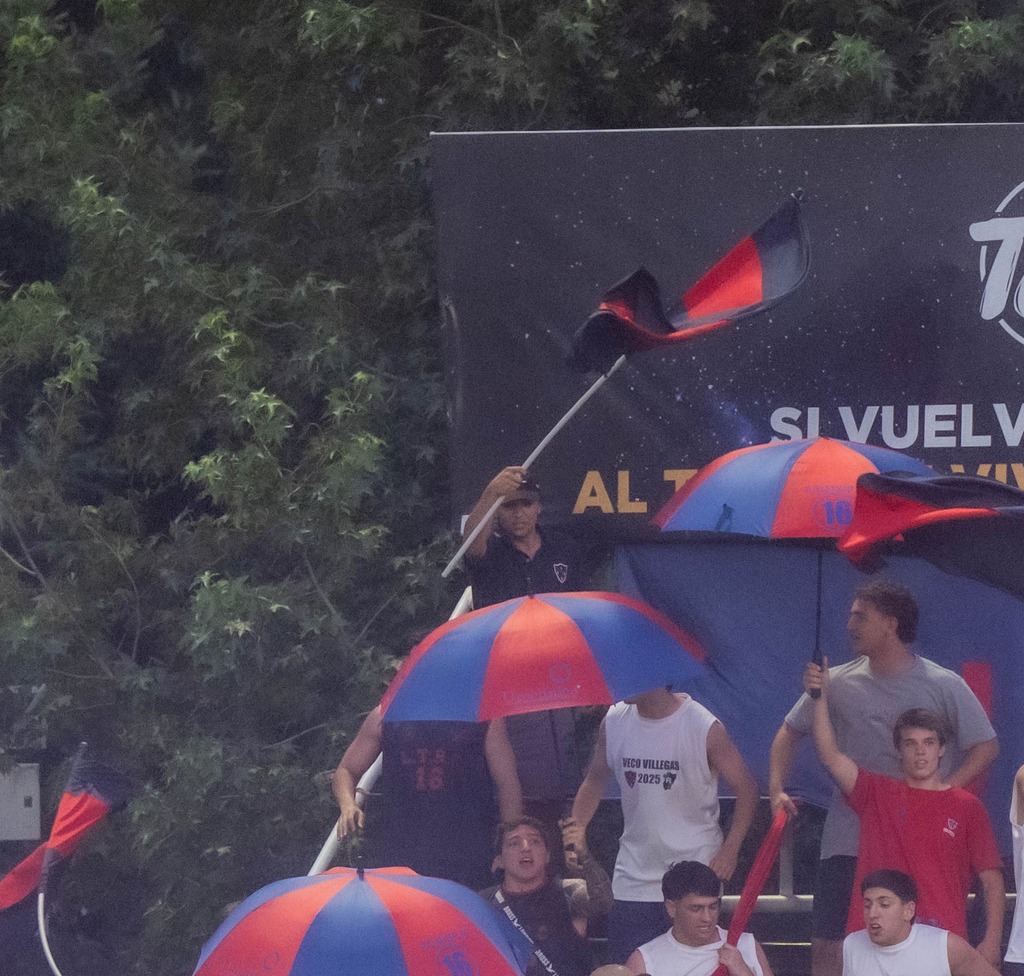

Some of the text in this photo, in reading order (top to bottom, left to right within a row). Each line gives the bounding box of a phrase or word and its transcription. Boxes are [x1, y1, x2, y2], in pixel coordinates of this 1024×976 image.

[769, 406, 820, 443] SI
[572, 470, 648, 515] AL
[622, 757, 680, 771] VECO VILLEGAS
[637, 773, 661, 785] 2025
